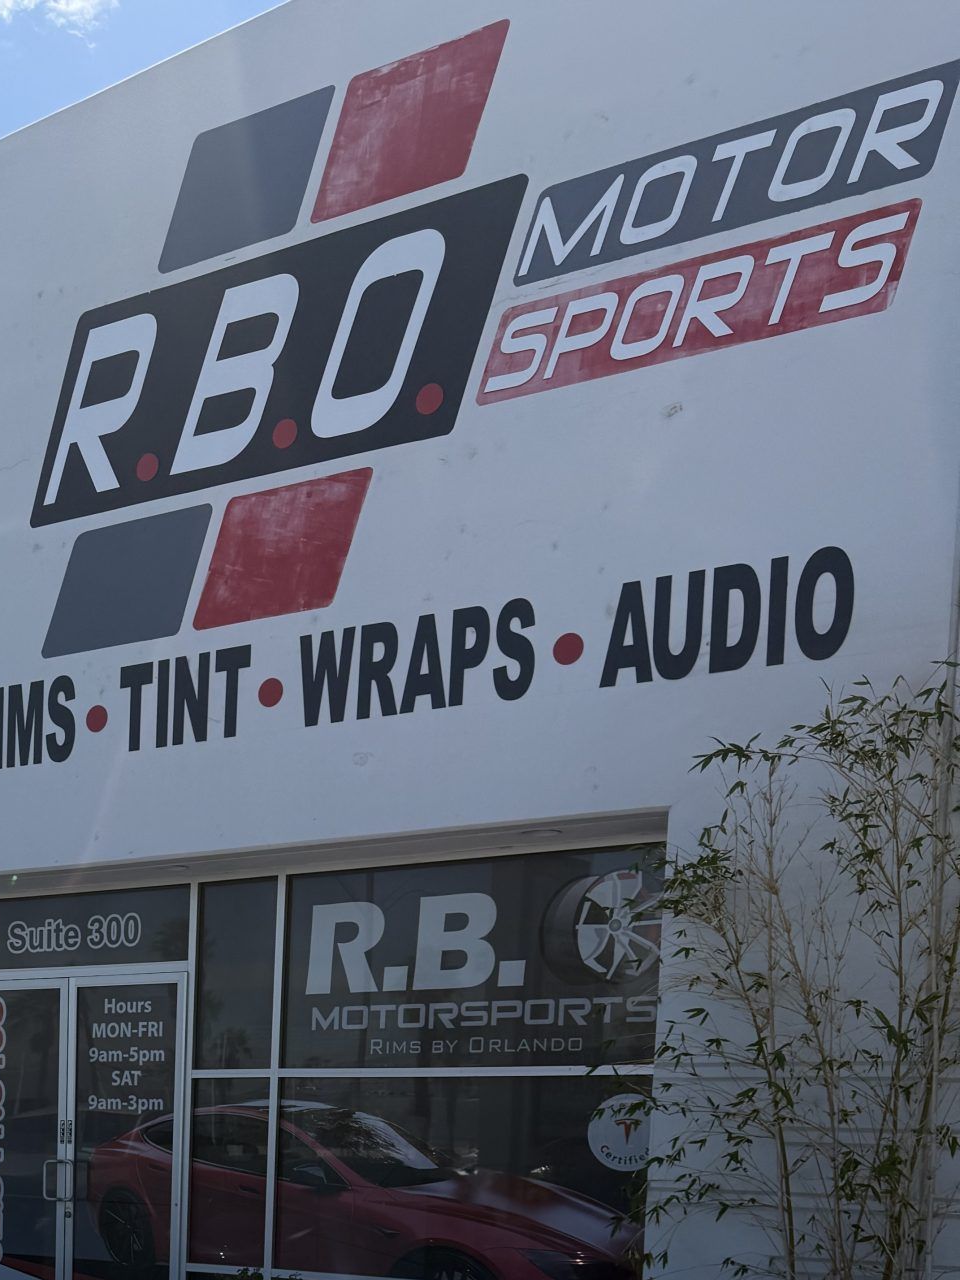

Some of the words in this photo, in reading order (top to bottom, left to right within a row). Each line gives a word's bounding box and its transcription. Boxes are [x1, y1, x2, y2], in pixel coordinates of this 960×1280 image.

[517, 77, 945, 277] MOTOR
[484, 210, 912, 394] SPORTS
[43, 228, 446, 507] R.B.O.
[120, 644, 251, 753] TINT
[300, 597, 536, 728] WRAPS
[599, 546, 856, 690] AUDIO
[7, 919, 81, 954] Suite
[87, 913, 141, 949] 300
[104, 998, 152, 1015] Hours
[311, 997, 657, 1031] MOTORSPORTS
[91, 1021, 163, 1039] MON-FRI
[88, 1047, 165, 1067] 9am-5pm
[370, 1038, 421, 1055] RIMS
[432, 1039, 457, 1054] BY
[469, 1036, 583, 1054] ORLANDO
[110, 1070, 140, 1087] SAT
[88, 1094, 164, 1114] 9am-3pm
